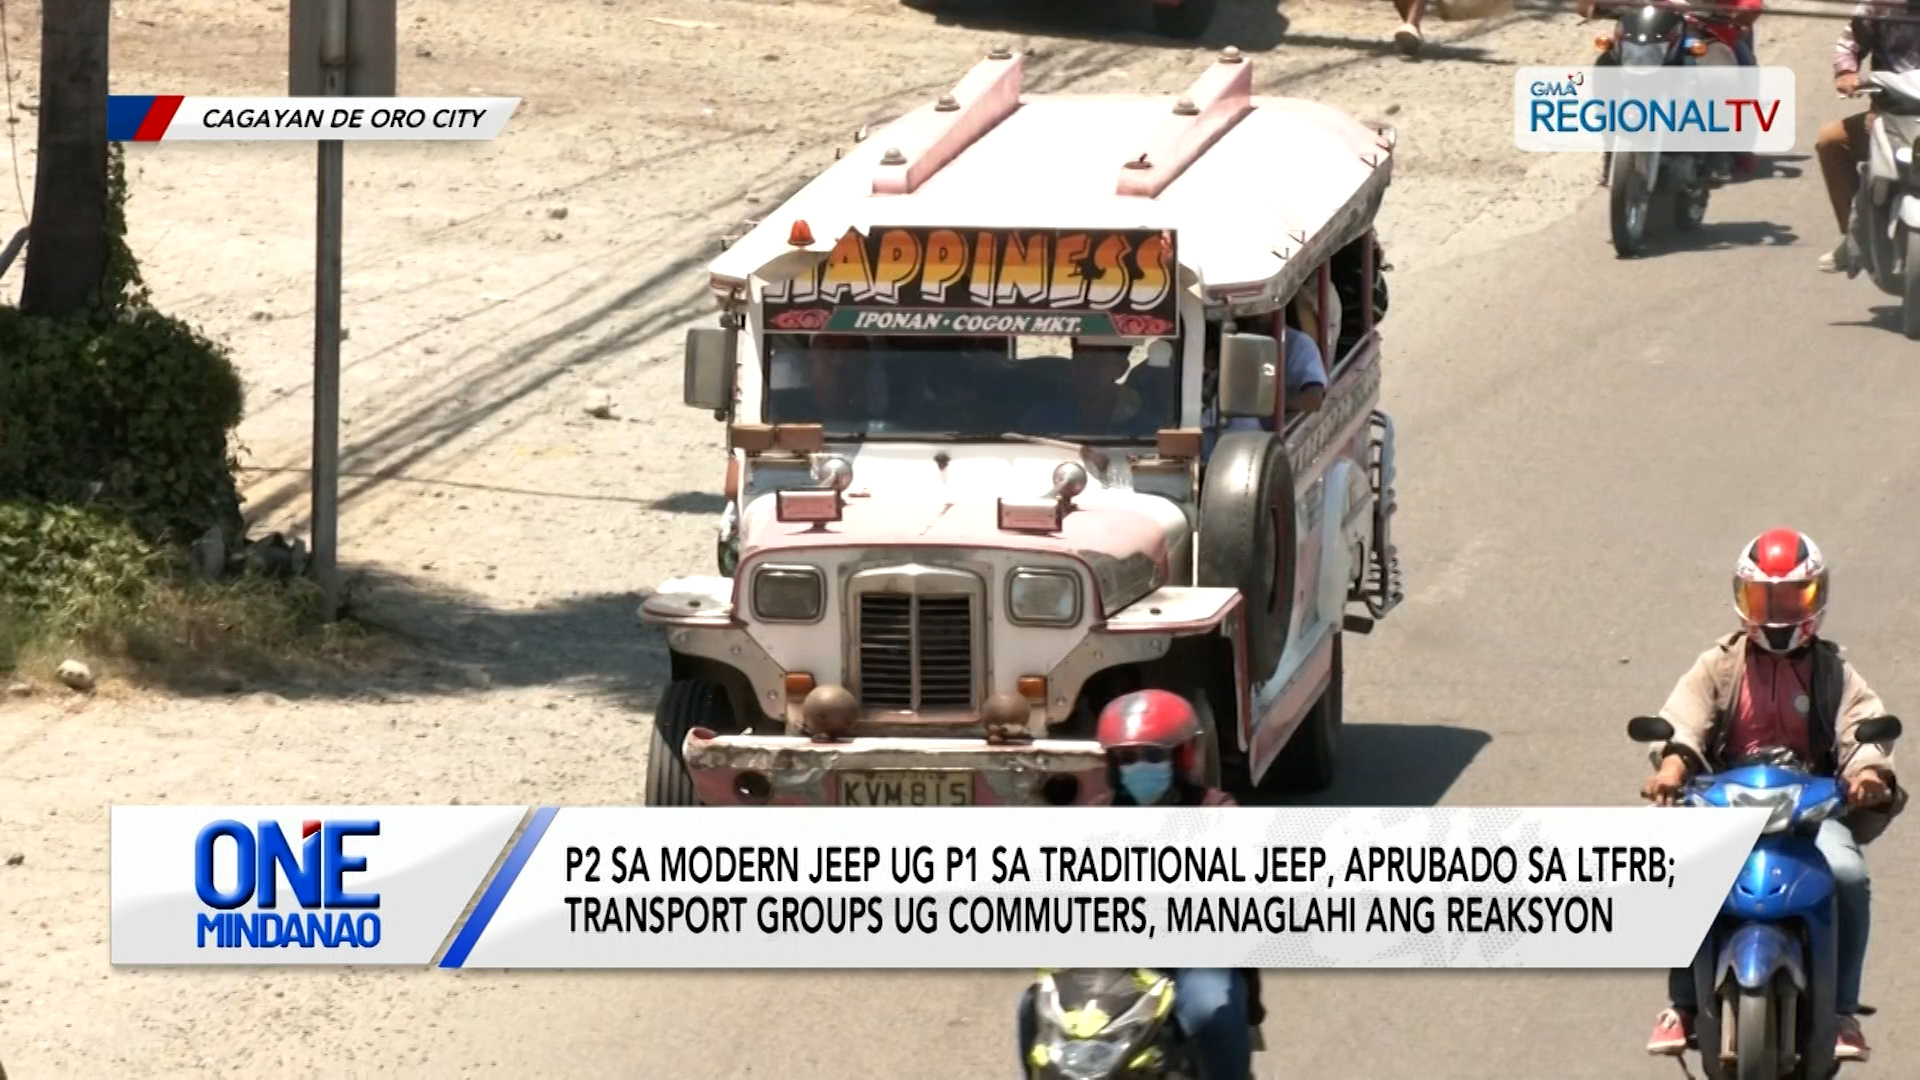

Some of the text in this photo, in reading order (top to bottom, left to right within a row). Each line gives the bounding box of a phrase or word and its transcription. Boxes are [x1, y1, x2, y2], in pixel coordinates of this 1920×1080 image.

[854, 312, 1083, 333] IPONAN COGON MKT.
